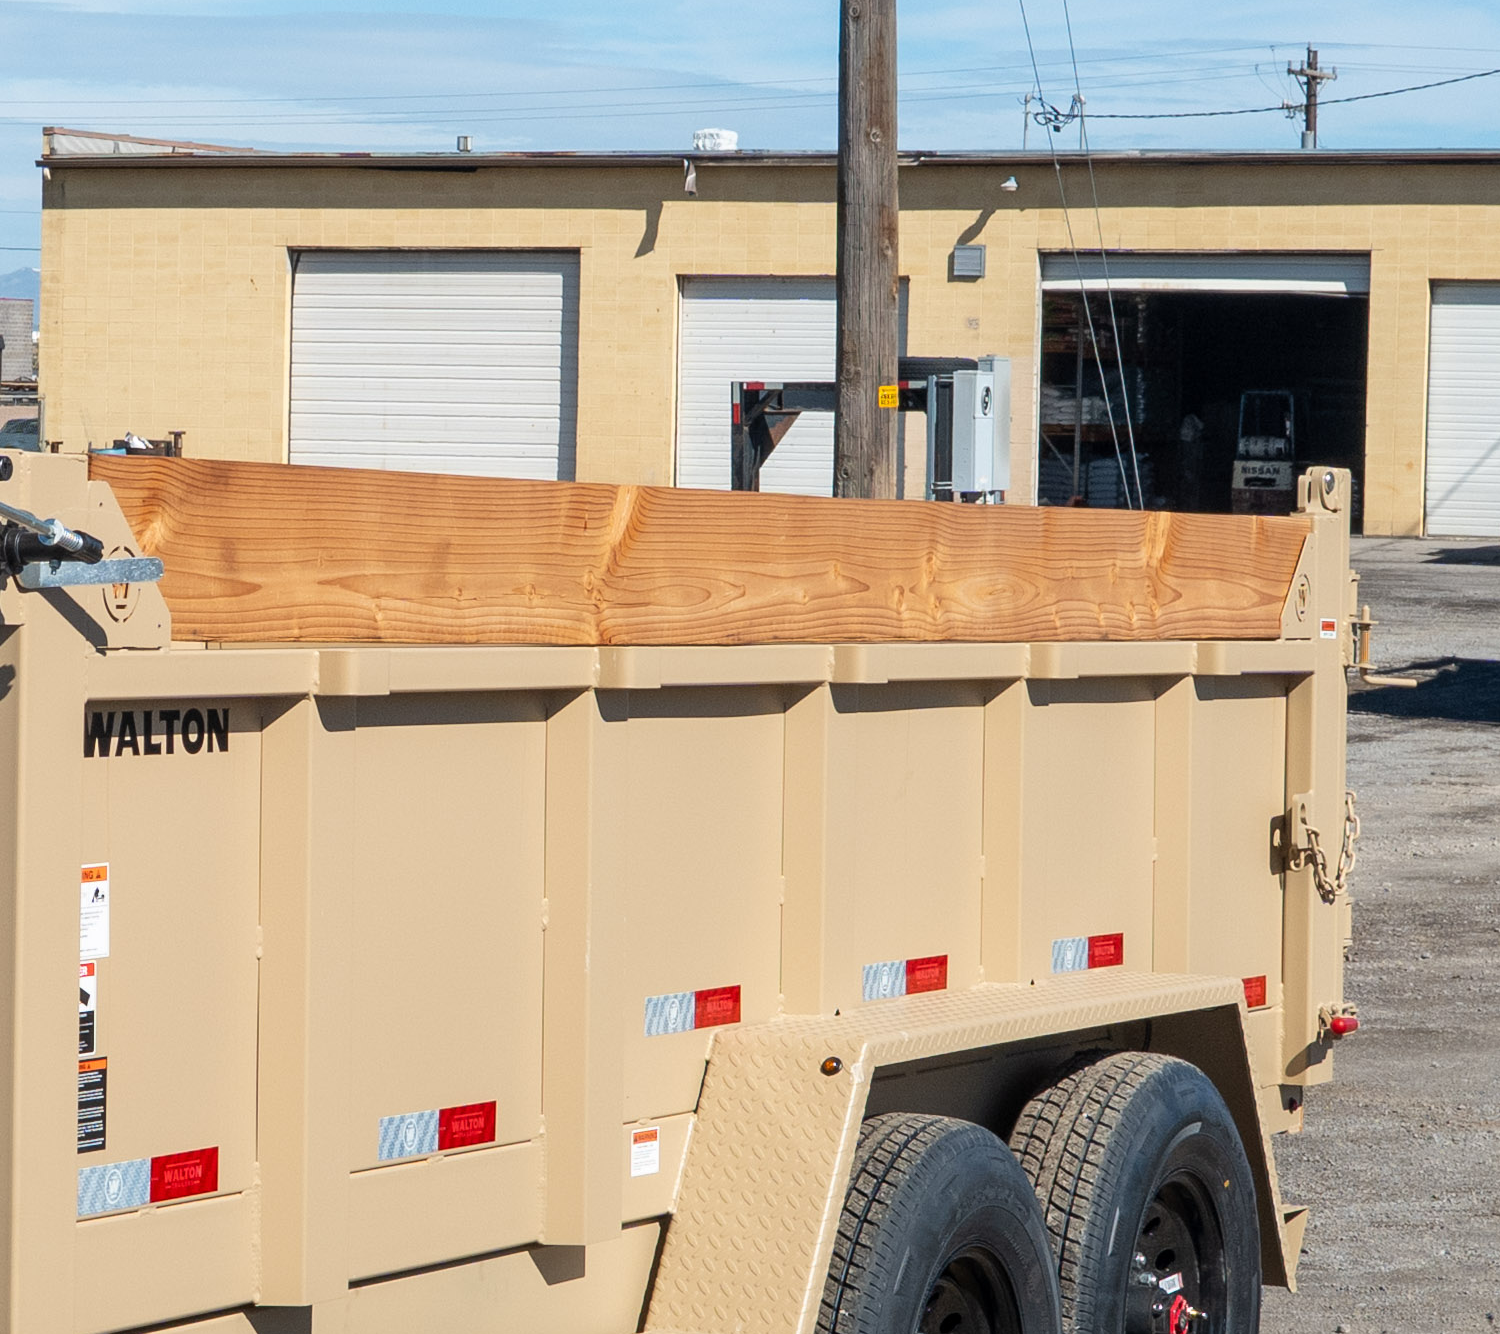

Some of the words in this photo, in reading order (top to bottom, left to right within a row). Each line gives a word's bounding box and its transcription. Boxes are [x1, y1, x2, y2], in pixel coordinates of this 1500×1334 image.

[1241, 466, 1280, 475] NISSAN
[84, 708, 229, 758] WALTON
[452, 1117, 485, 1133] WALTON
[164, 1165, 202, 1183] WALTON
